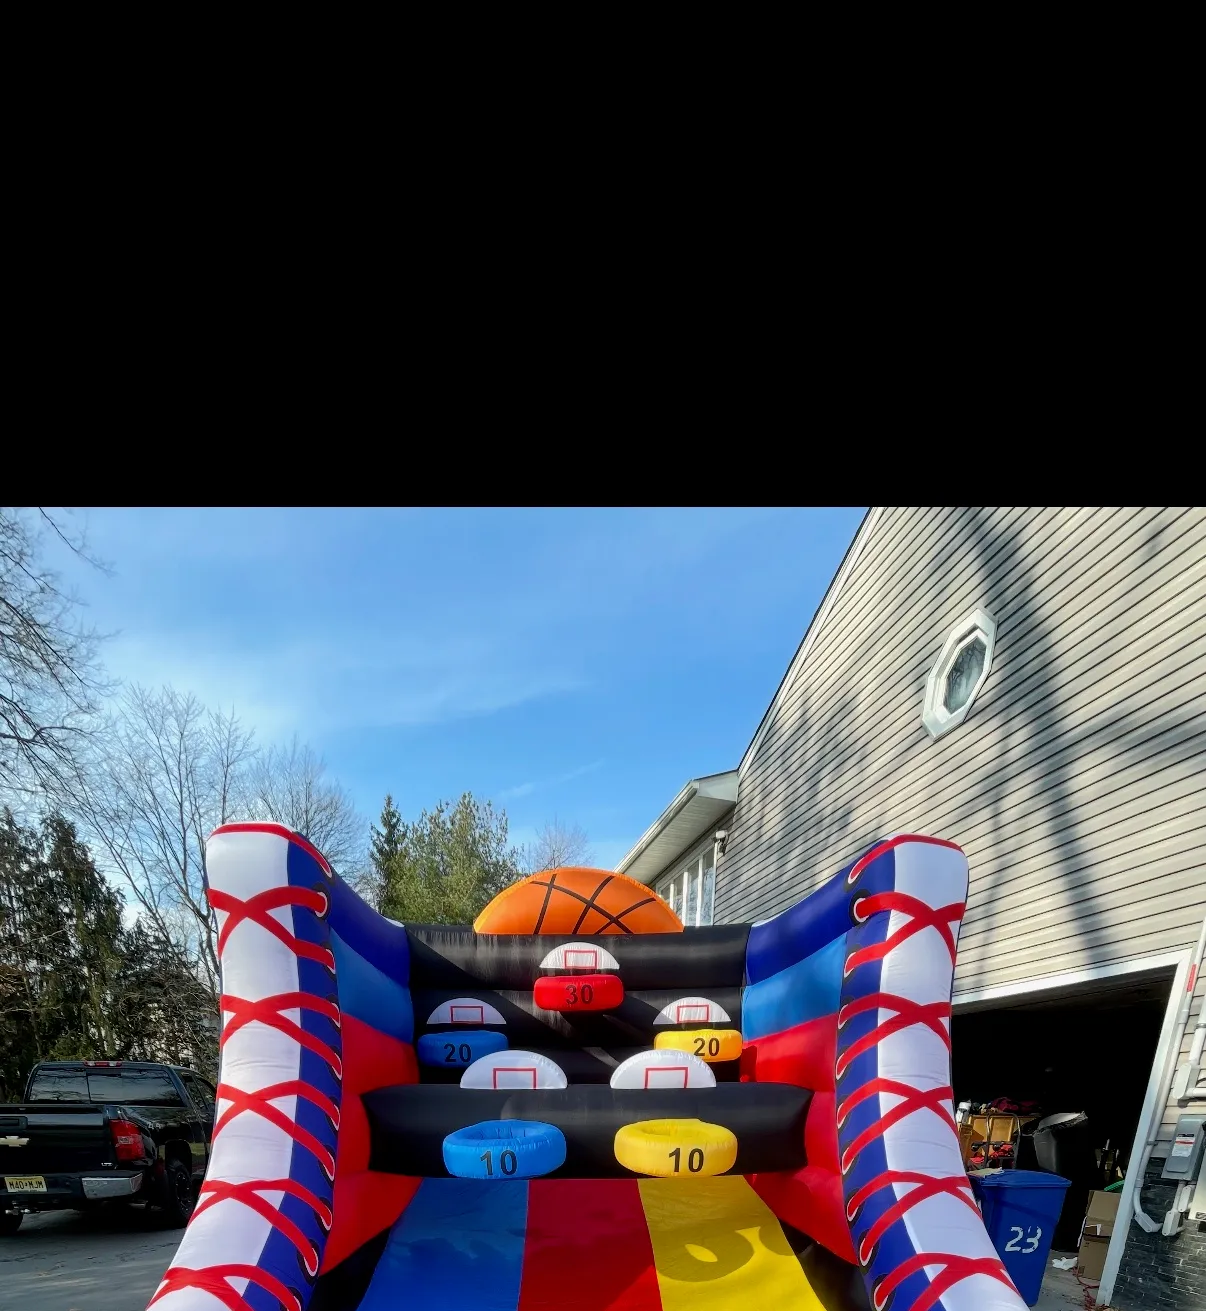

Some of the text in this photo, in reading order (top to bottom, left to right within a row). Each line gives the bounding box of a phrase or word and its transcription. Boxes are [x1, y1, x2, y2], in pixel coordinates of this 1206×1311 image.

[565, 984, 594, 1005] 30
[444, 1043, 472, 1063] 20
[693, 1037, 720, 1057] 20
[480, 1149, 518, 1176] 10
[668, 1147, 704, 1173] 10
[1004, 1225, 1042, 1254] 23
